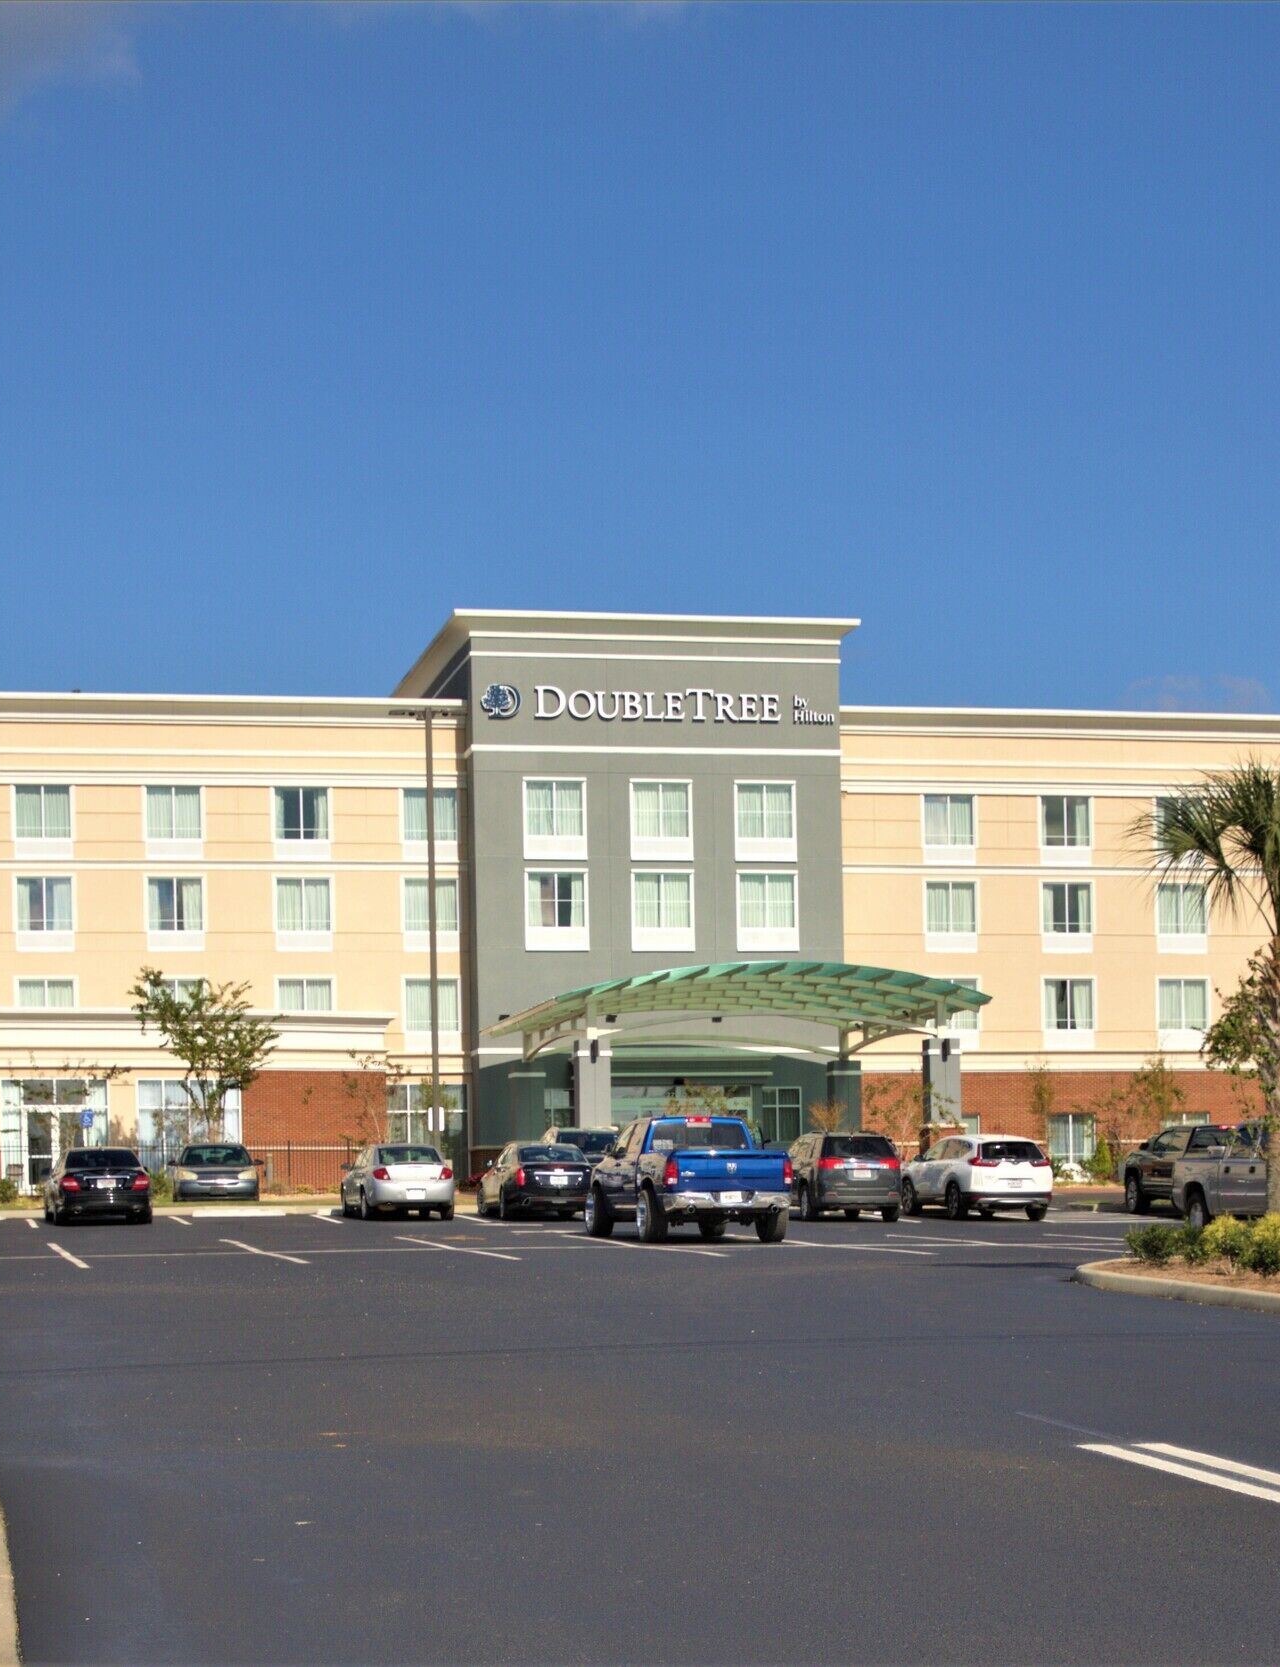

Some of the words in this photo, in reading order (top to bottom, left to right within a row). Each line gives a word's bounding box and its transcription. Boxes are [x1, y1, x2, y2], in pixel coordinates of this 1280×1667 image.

[534, 686, 782, 722] DOUBLETREE
[793, 695, 808, 710] by
[794, 710, 835, 723] Hilton
